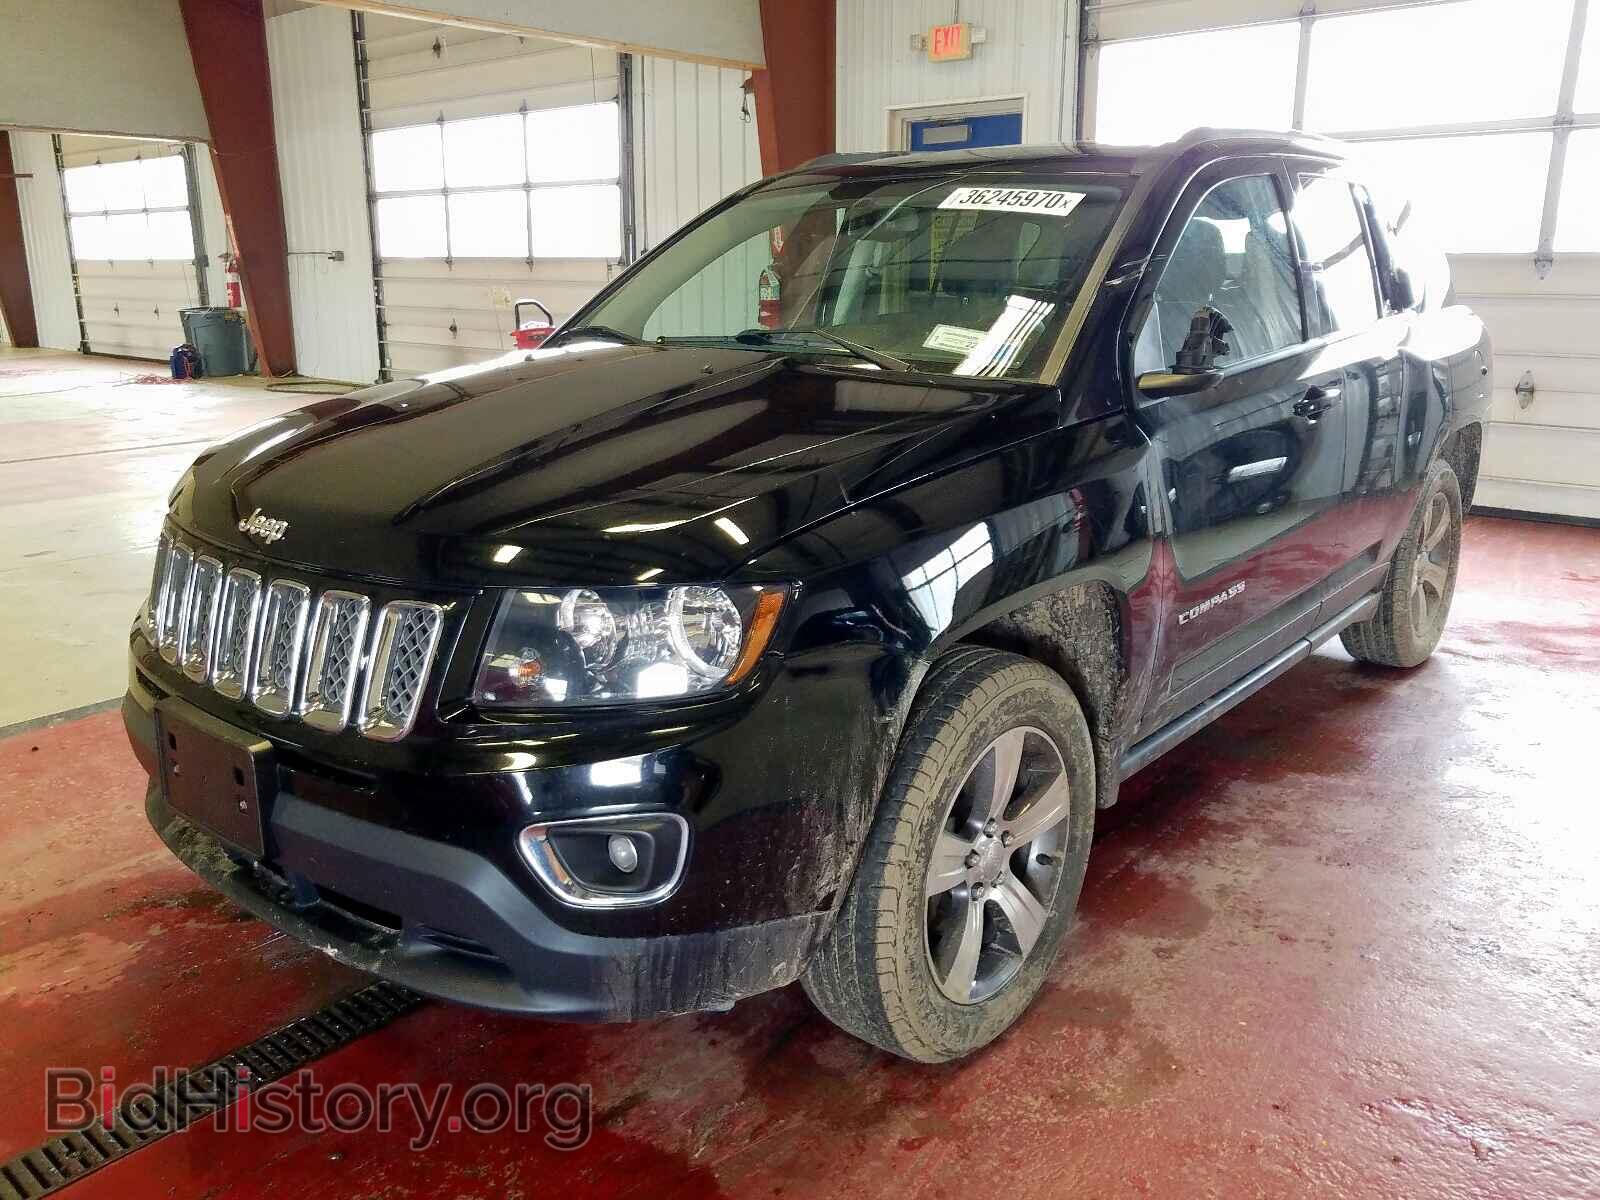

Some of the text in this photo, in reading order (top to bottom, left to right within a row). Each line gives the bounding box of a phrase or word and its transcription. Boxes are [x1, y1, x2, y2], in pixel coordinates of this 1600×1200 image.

[934, 25, 962, 55] EXIT
[238, 507, 289, 545] Jeep
[1178, 580, 1246, 625] COMPASS
